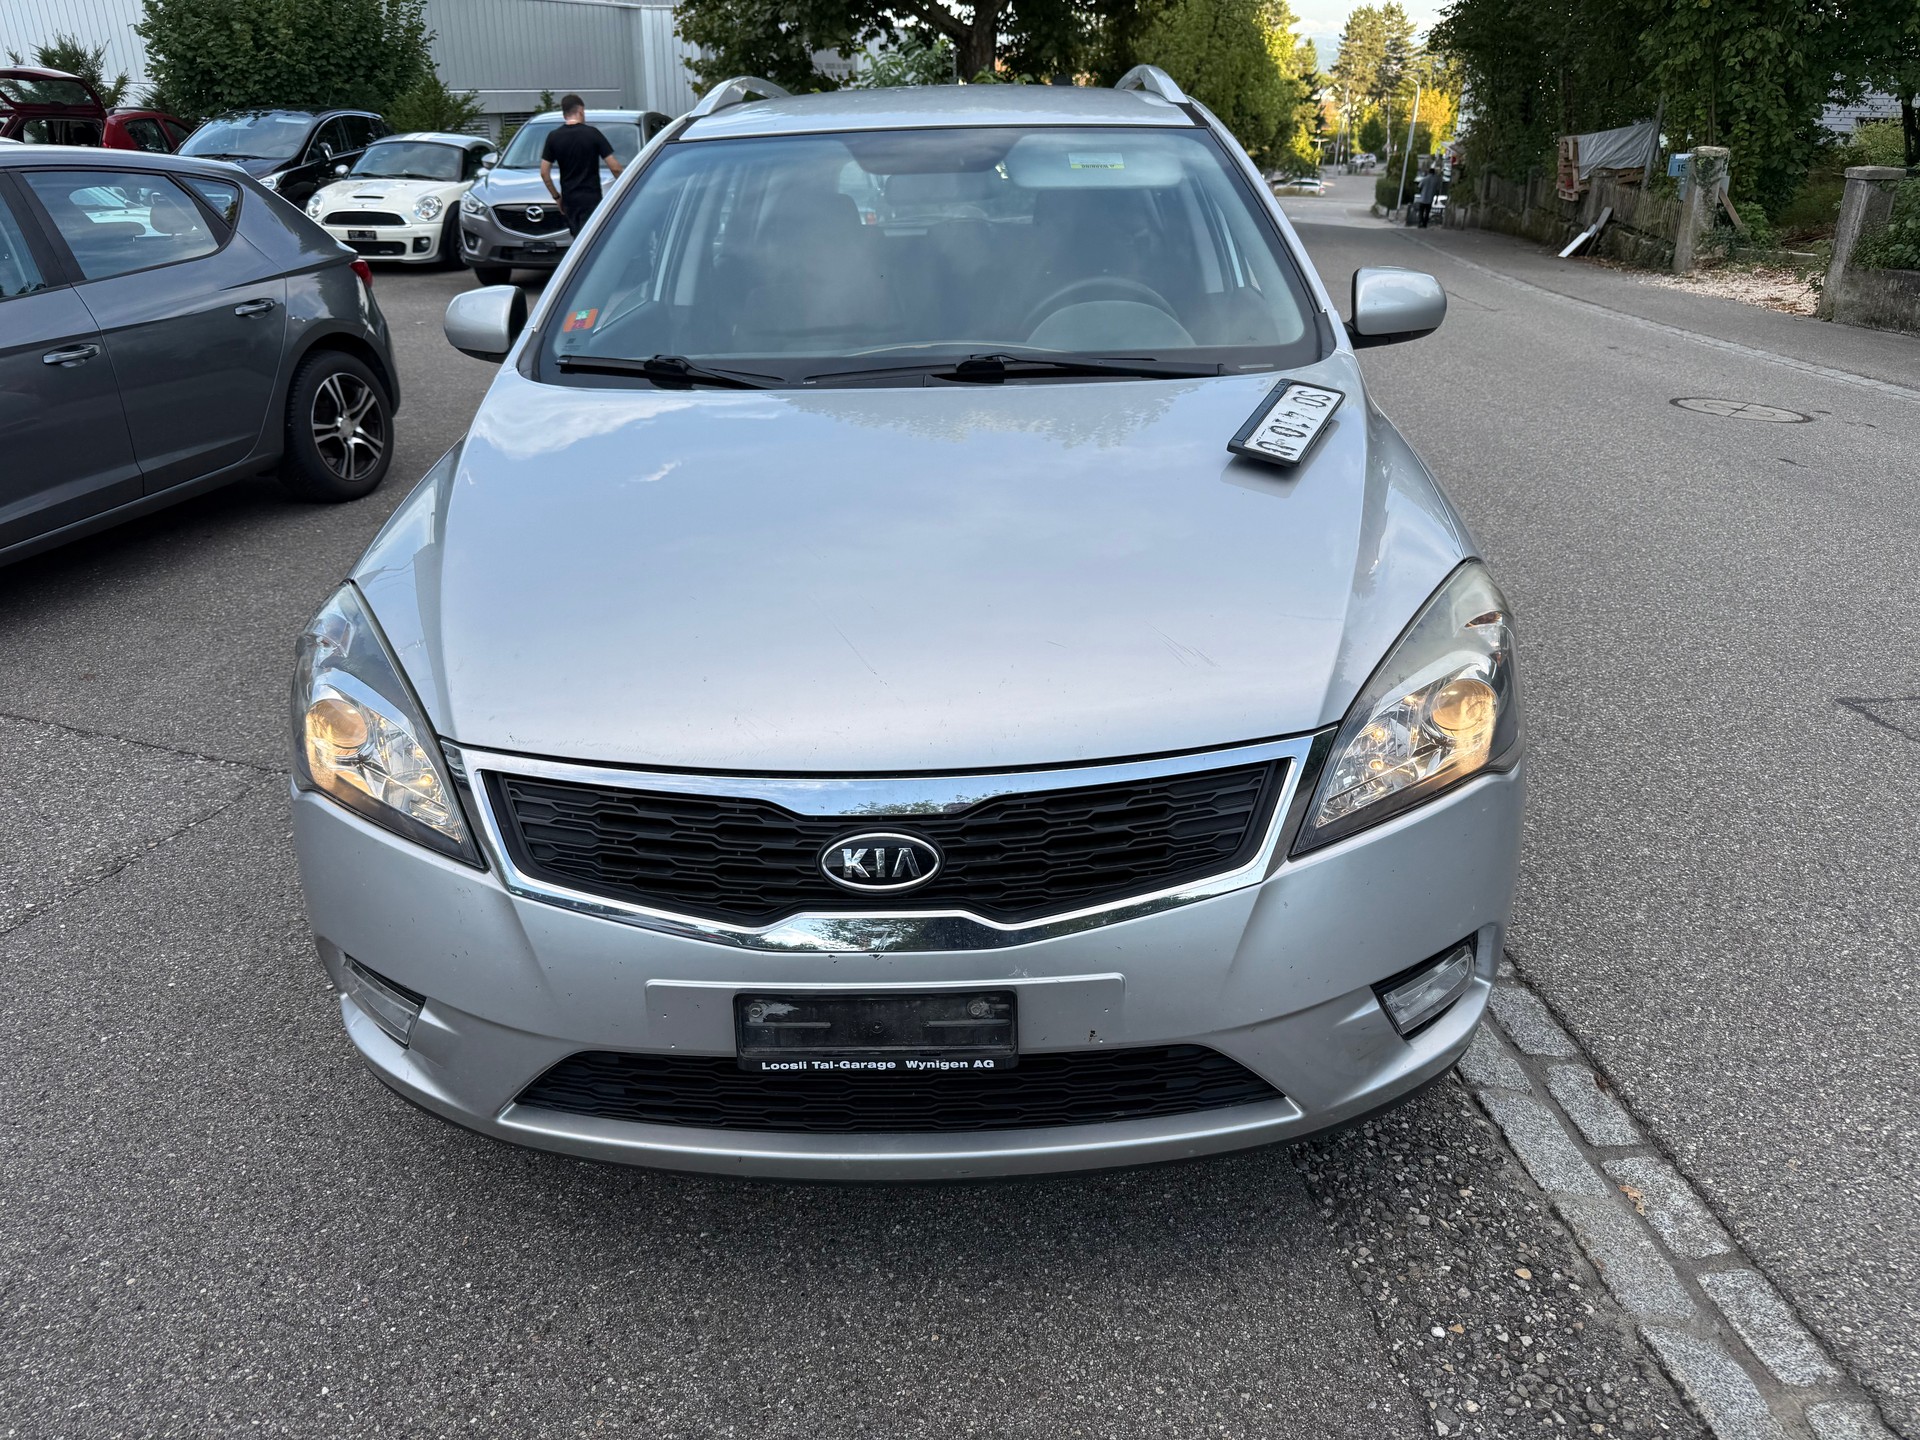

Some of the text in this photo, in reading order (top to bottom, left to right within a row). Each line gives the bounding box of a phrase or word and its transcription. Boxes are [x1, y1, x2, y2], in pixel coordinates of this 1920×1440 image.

[1292, 390, 1332, 408] SO
[841, 847, 922, 878] KIA
[761, 1059, 995, 1070] Loosli Tal-Garage Wynigen AG
